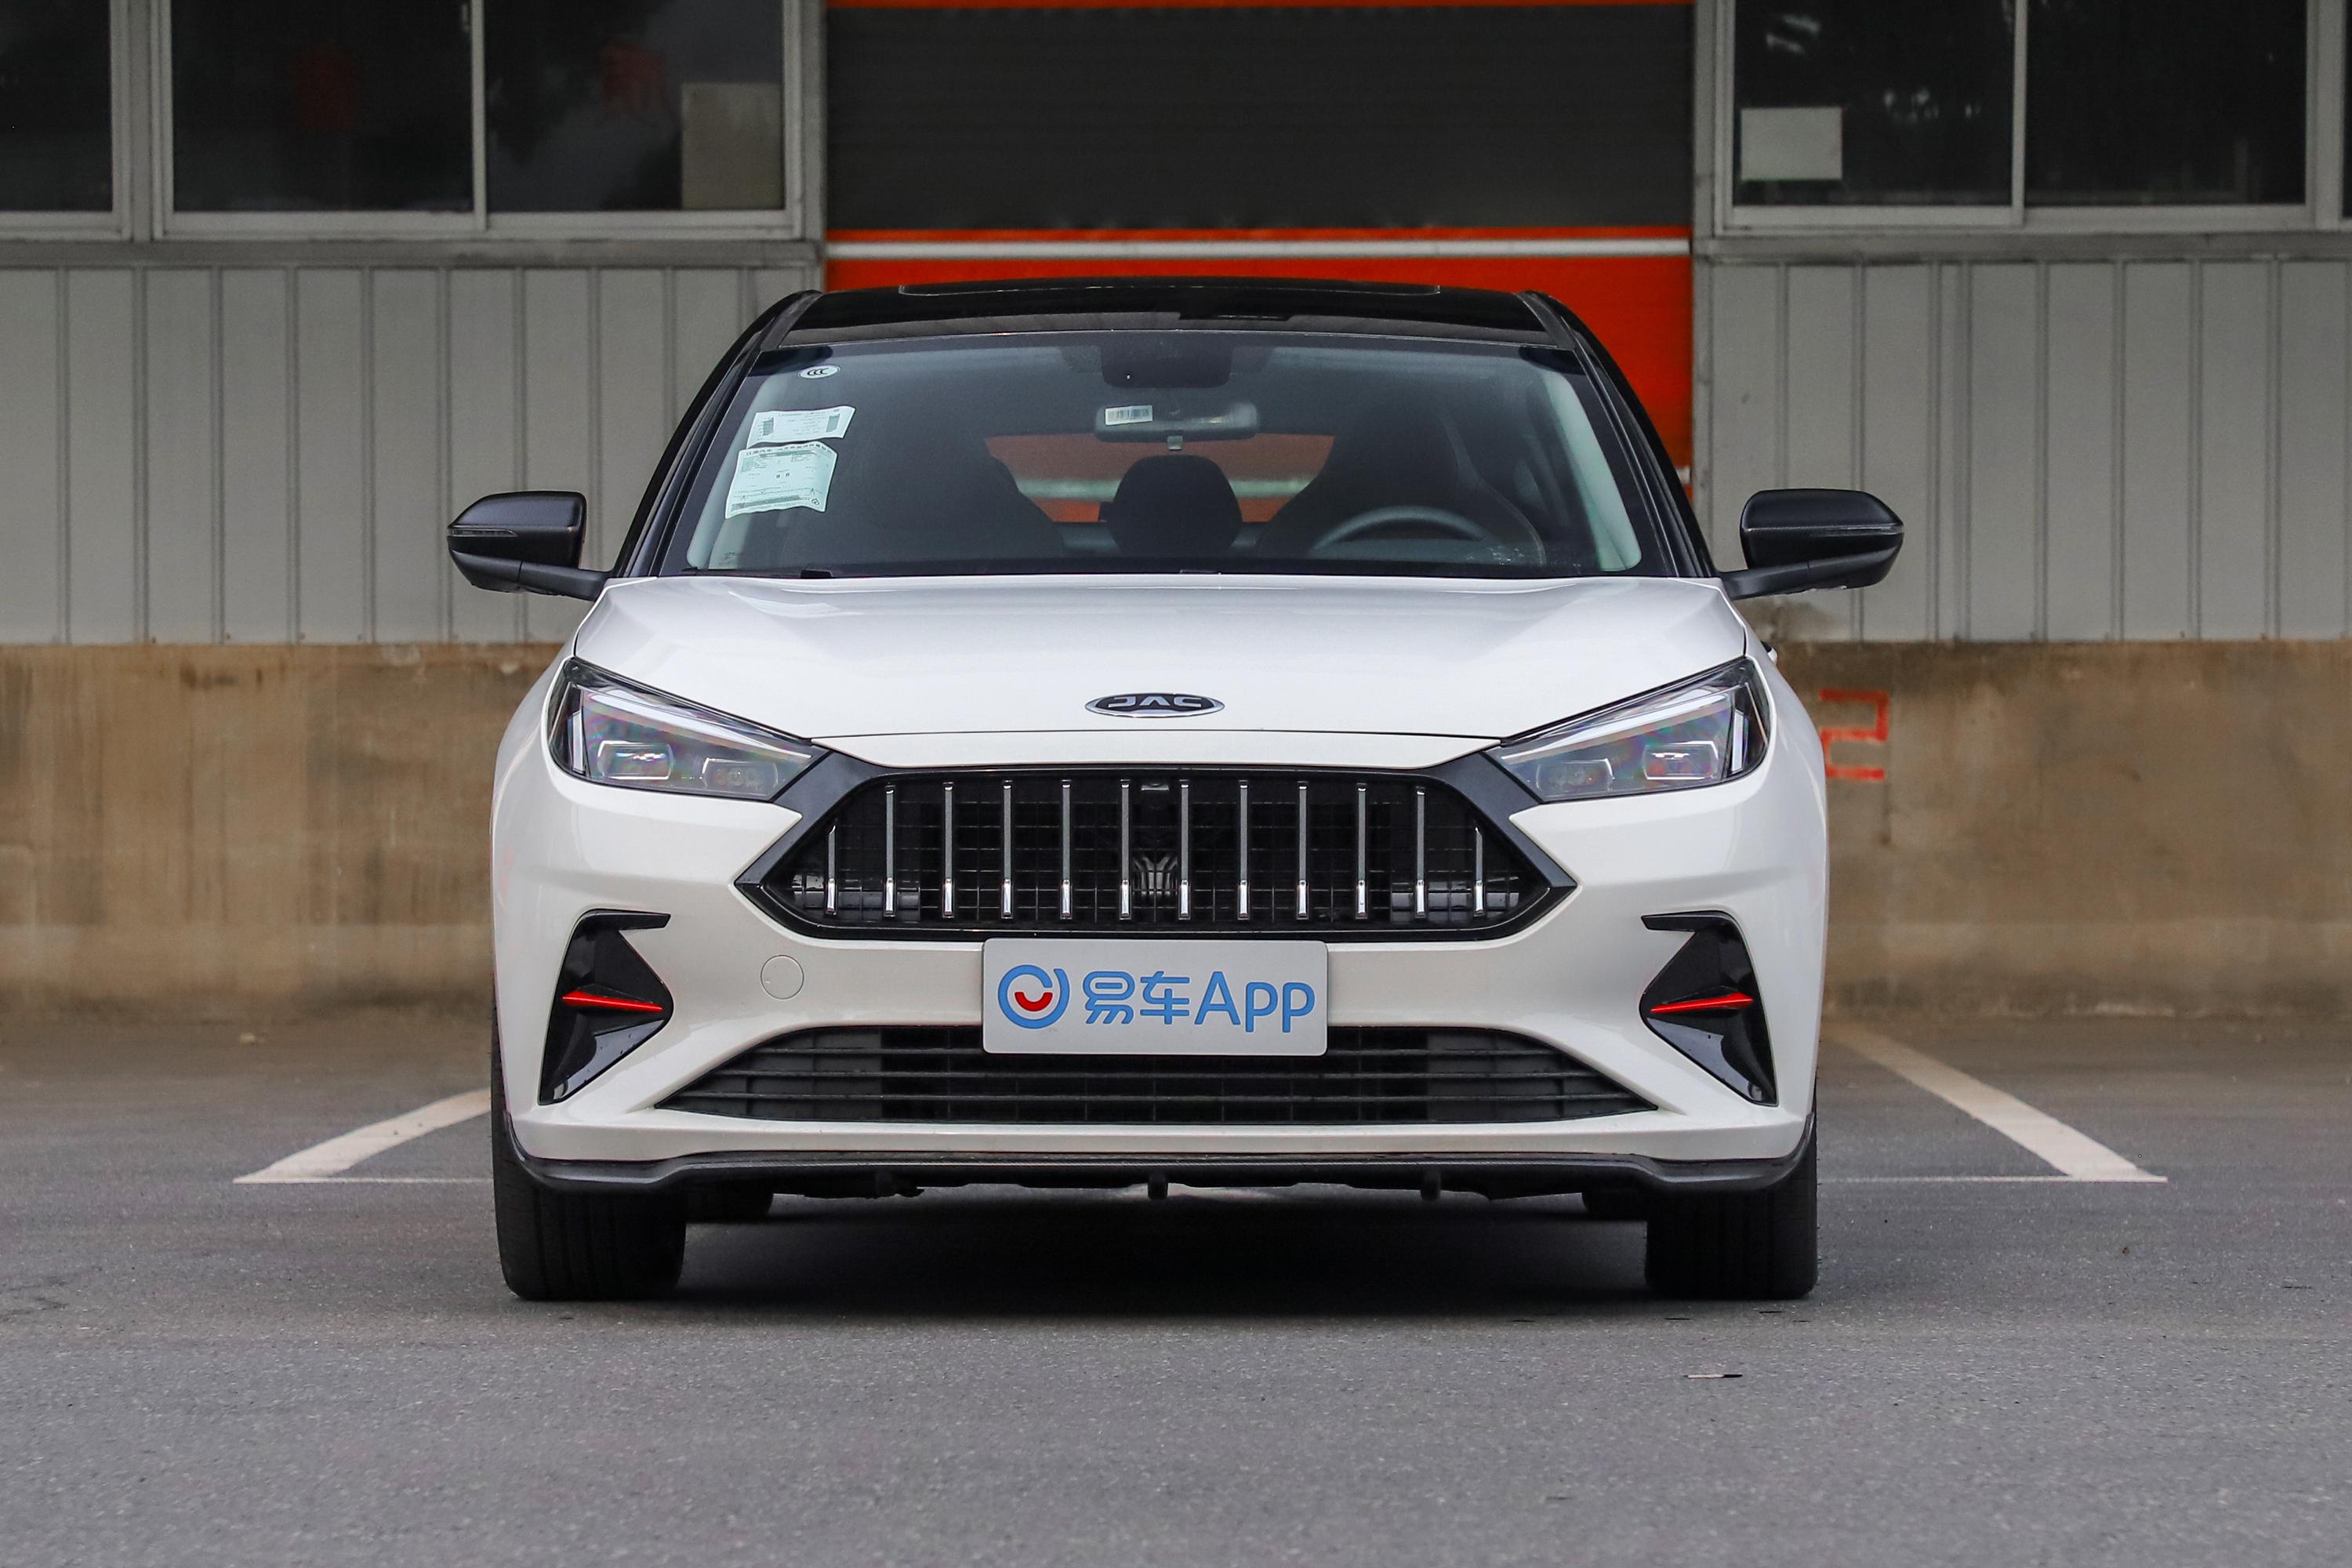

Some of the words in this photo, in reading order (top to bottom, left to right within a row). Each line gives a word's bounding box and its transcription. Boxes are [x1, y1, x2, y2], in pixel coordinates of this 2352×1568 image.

[1107, 695, 1203, 709] JAC
[1818, 687, 1889, 782] 2
[1081, 970, 1317, 1034] 易车App
